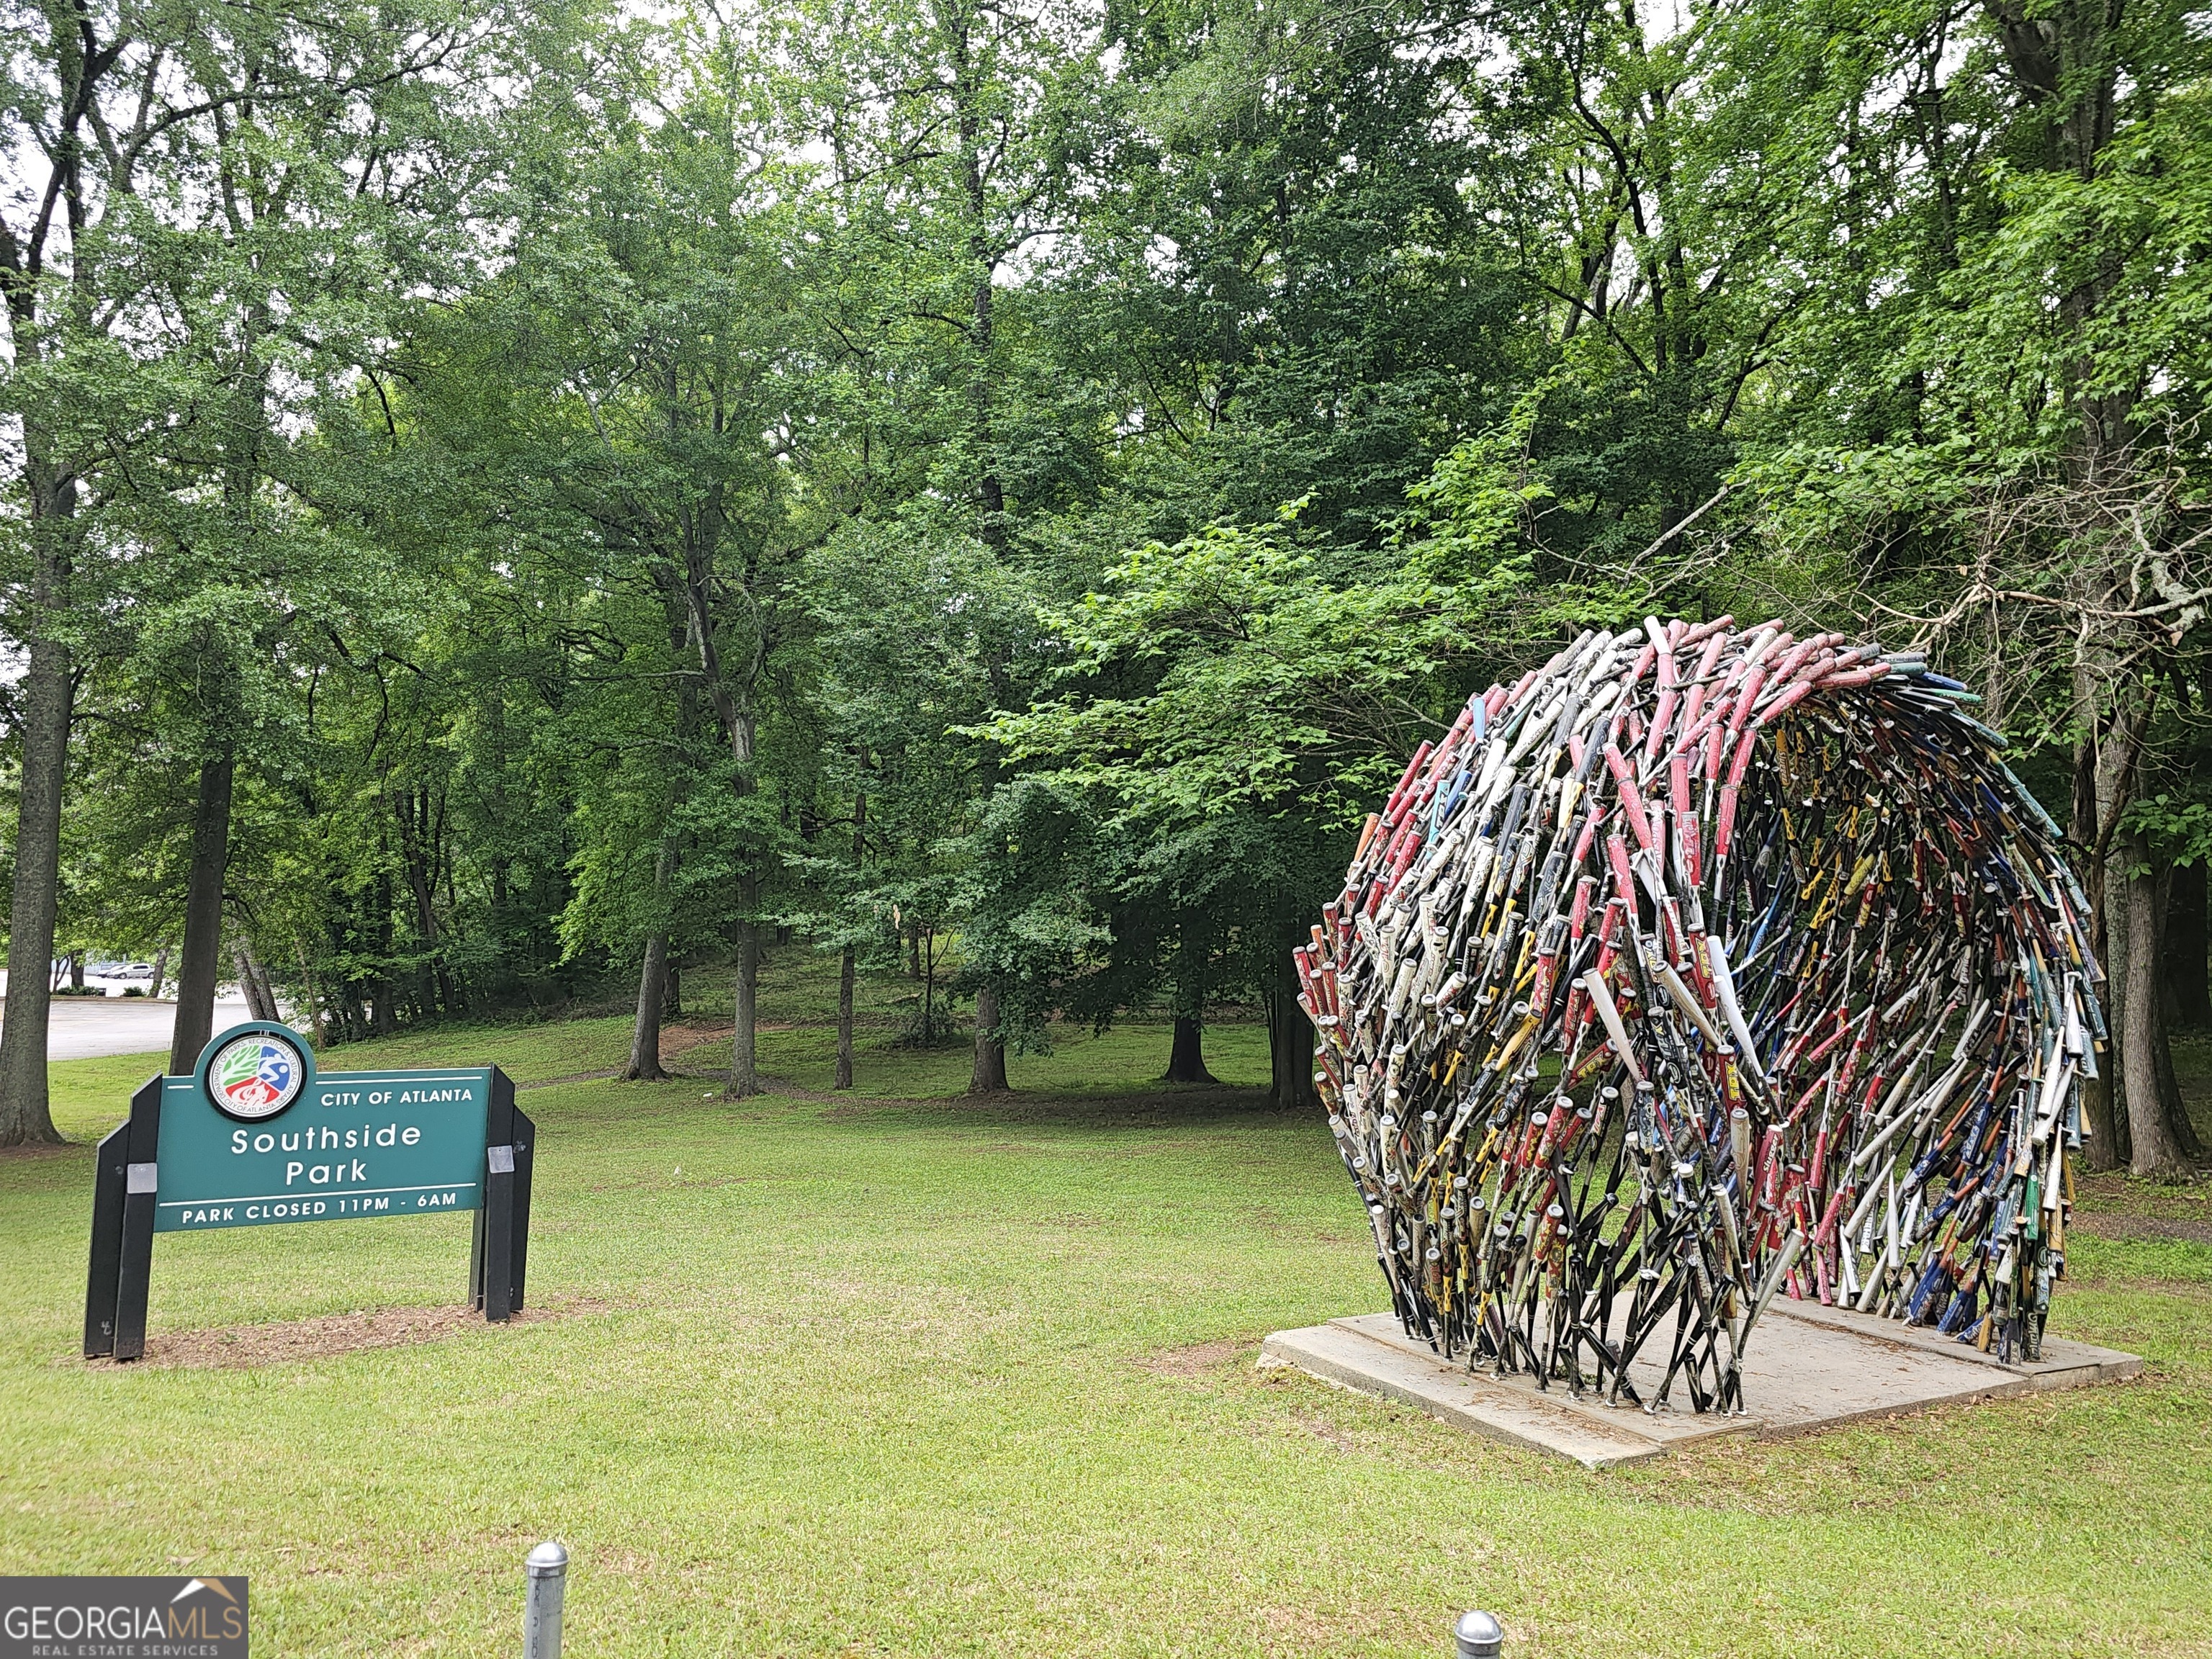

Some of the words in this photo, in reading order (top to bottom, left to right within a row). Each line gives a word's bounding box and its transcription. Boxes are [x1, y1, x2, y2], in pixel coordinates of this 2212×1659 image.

[1577, 1052, 1607, 1079] TPX
[1725, 1061, 1741, 1102] TPX
[320, 1092, 361, 1107] CITY
[368, 1091, 392, 1105] OF
[400, 1089, 472, 1103] ATLANTA
[230, 1123, 421, 1154] Southside
[286, 1159, 367, 1186] Park
[182, 1208, 234, 1224] PARK
[246, 1200, 326, 1220] CLOSED
[339, 1197, 390, 1213] 11PM
[418, 1192, 456, 1208] 6AM
